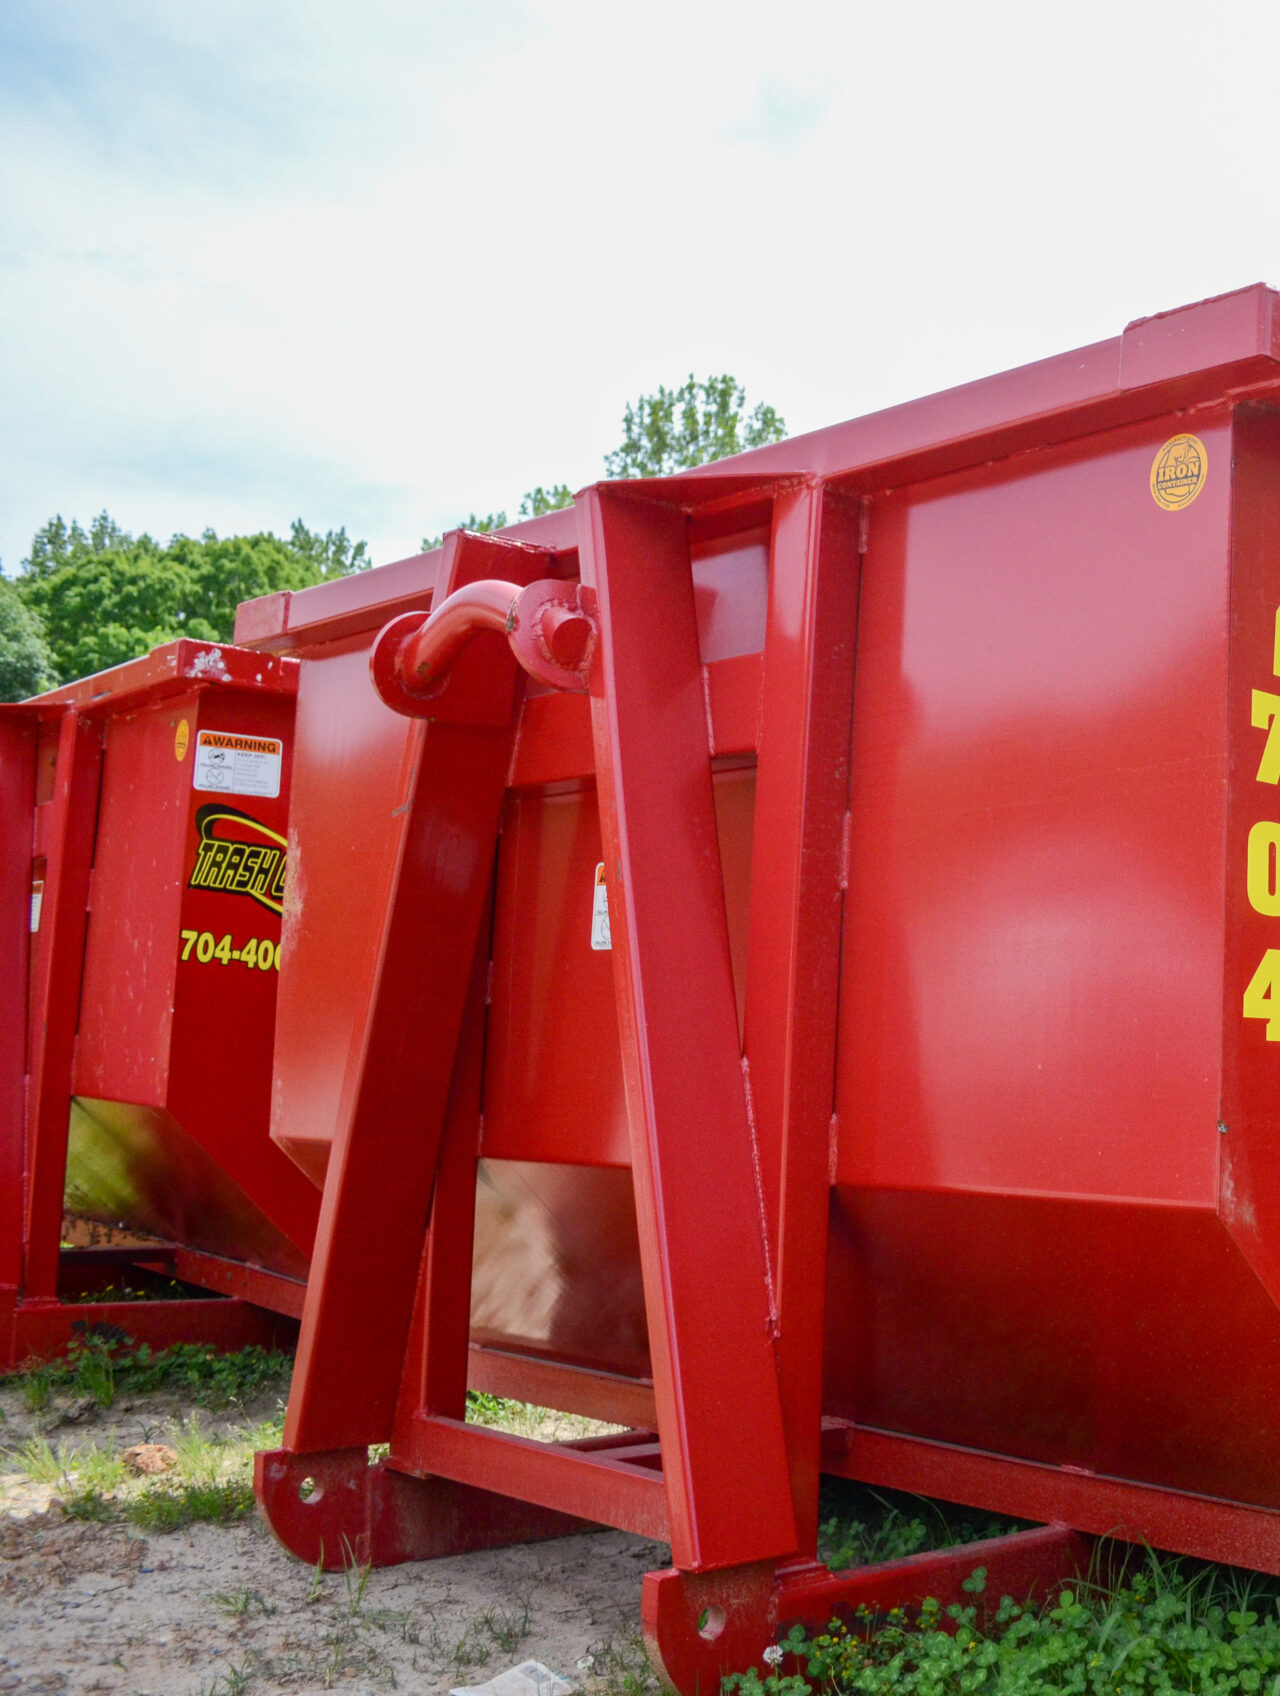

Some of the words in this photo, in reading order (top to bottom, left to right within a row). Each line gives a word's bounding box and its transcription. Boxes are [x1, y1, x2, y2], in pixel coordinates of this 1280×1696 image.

[1157, 461, 1201, 482] IRON
[1157, 476, 1198, 489] CONTAINER
[213, 735, 276, 753] WARNING
[189, 838, 281, 895] TRASH
